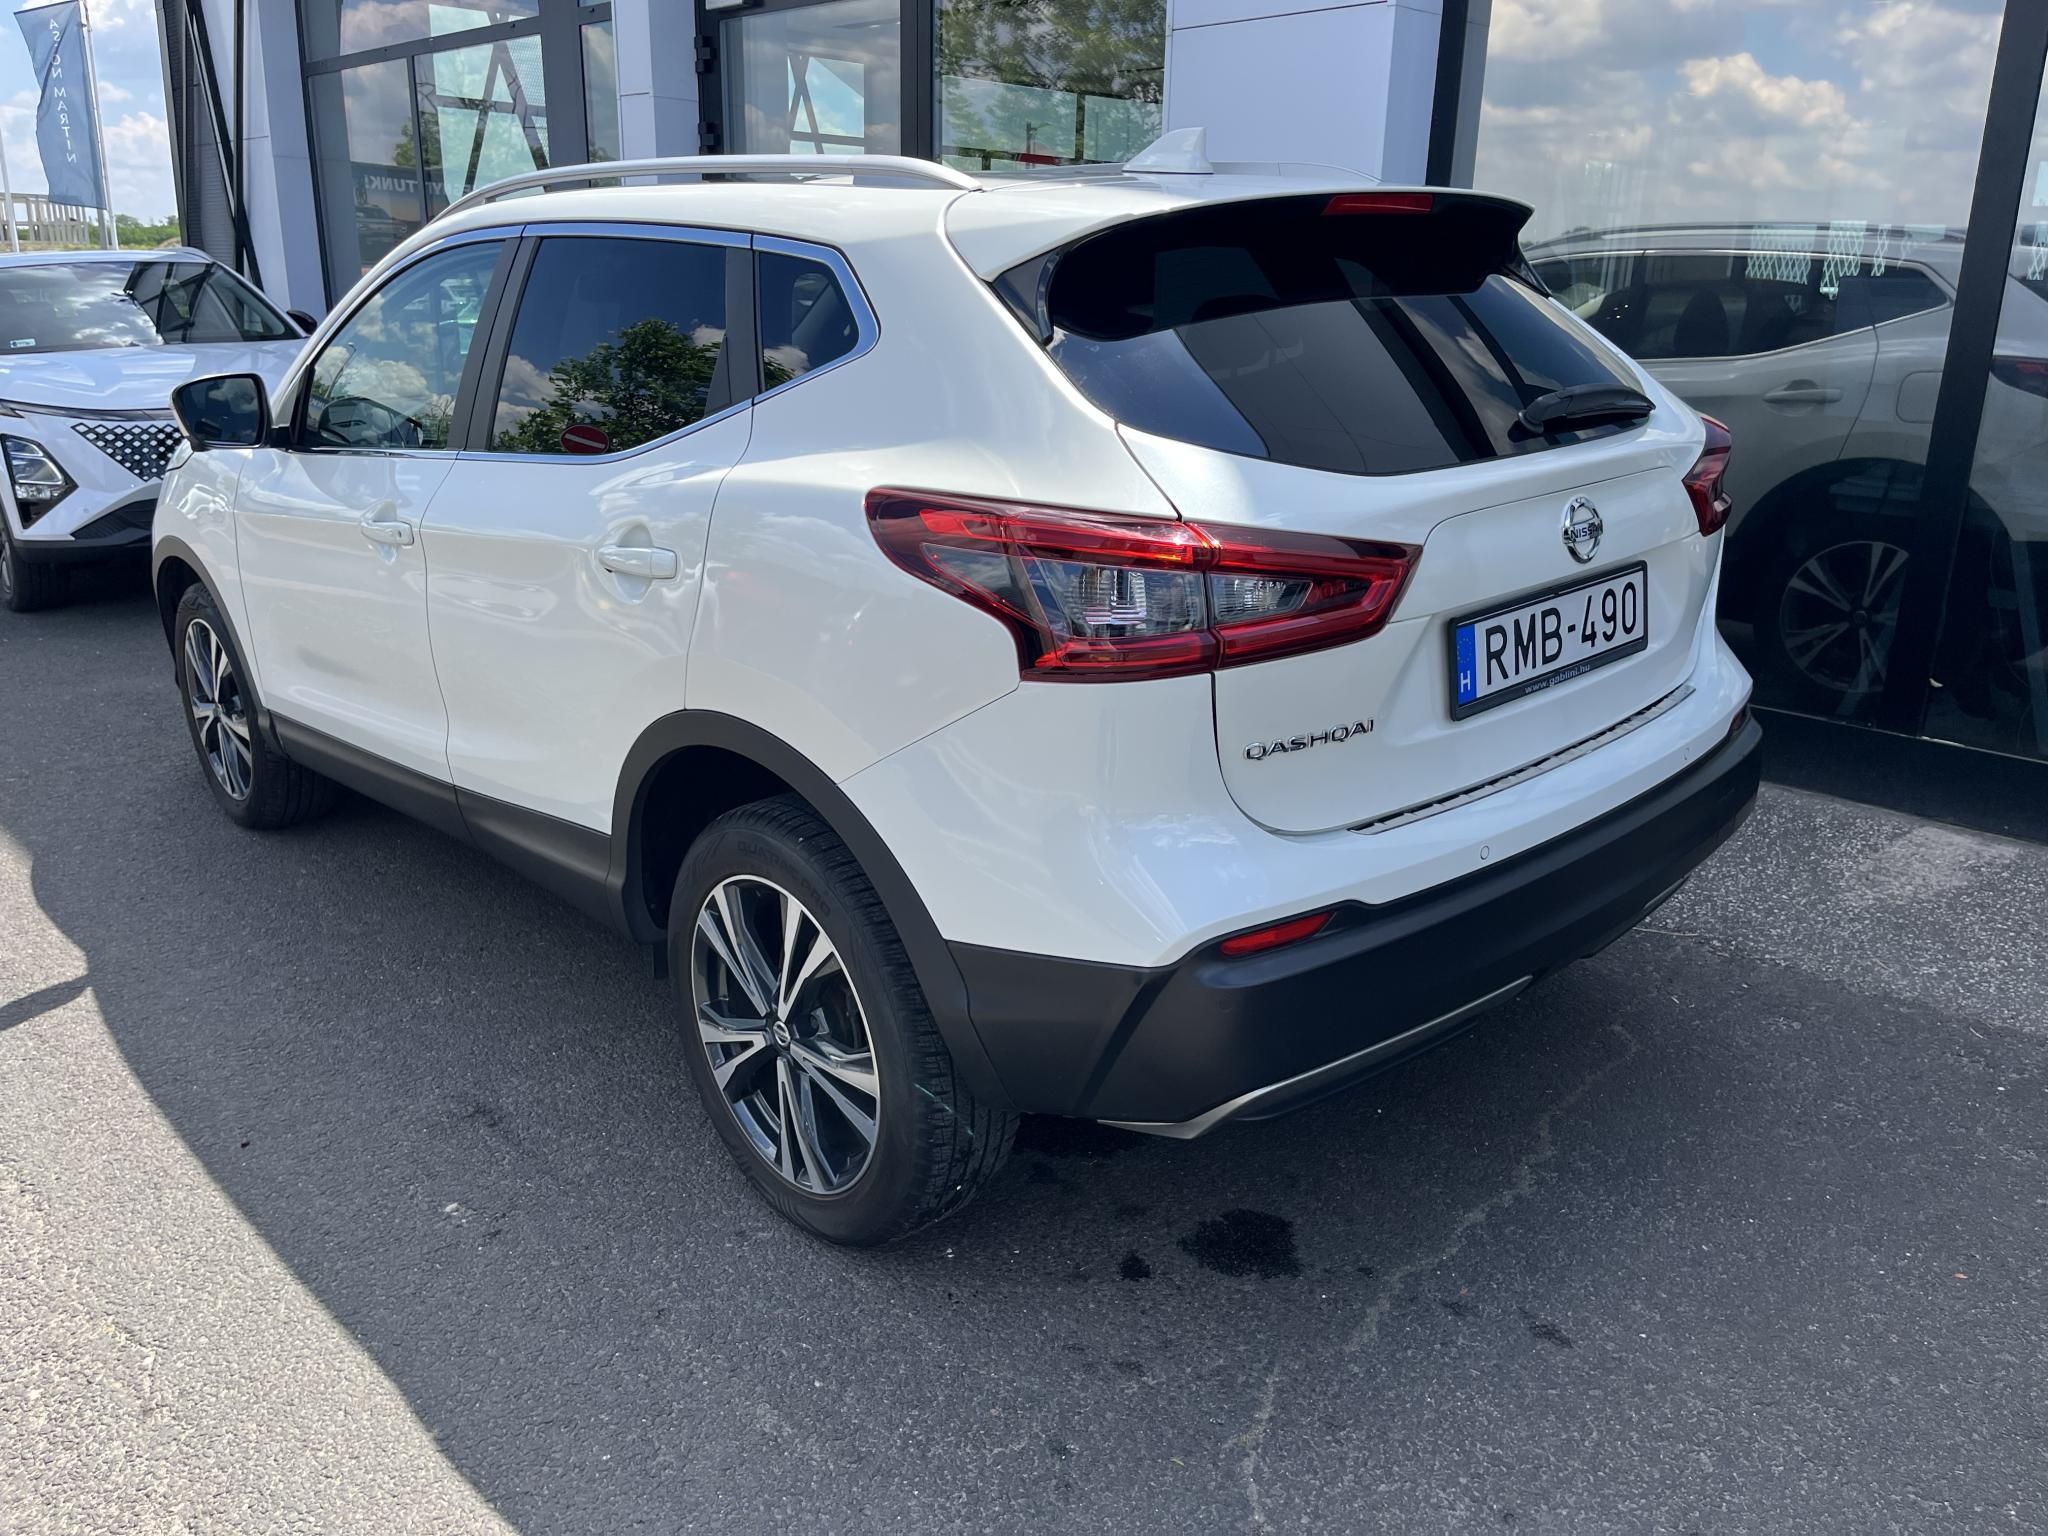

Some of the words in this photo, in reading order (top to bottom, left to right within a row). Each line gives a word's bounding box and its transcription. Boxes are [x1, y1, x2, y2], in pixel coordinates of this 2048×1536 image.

[1570, 522, 1601, 540] NISS
[1485, 581, 1637, 686] RMB-490
[1459, 670, 1472, 693] H
[1525, 663, 1591, 695] www.gablini.hu
[1243, 717, 1374, 761] QASHQAI
